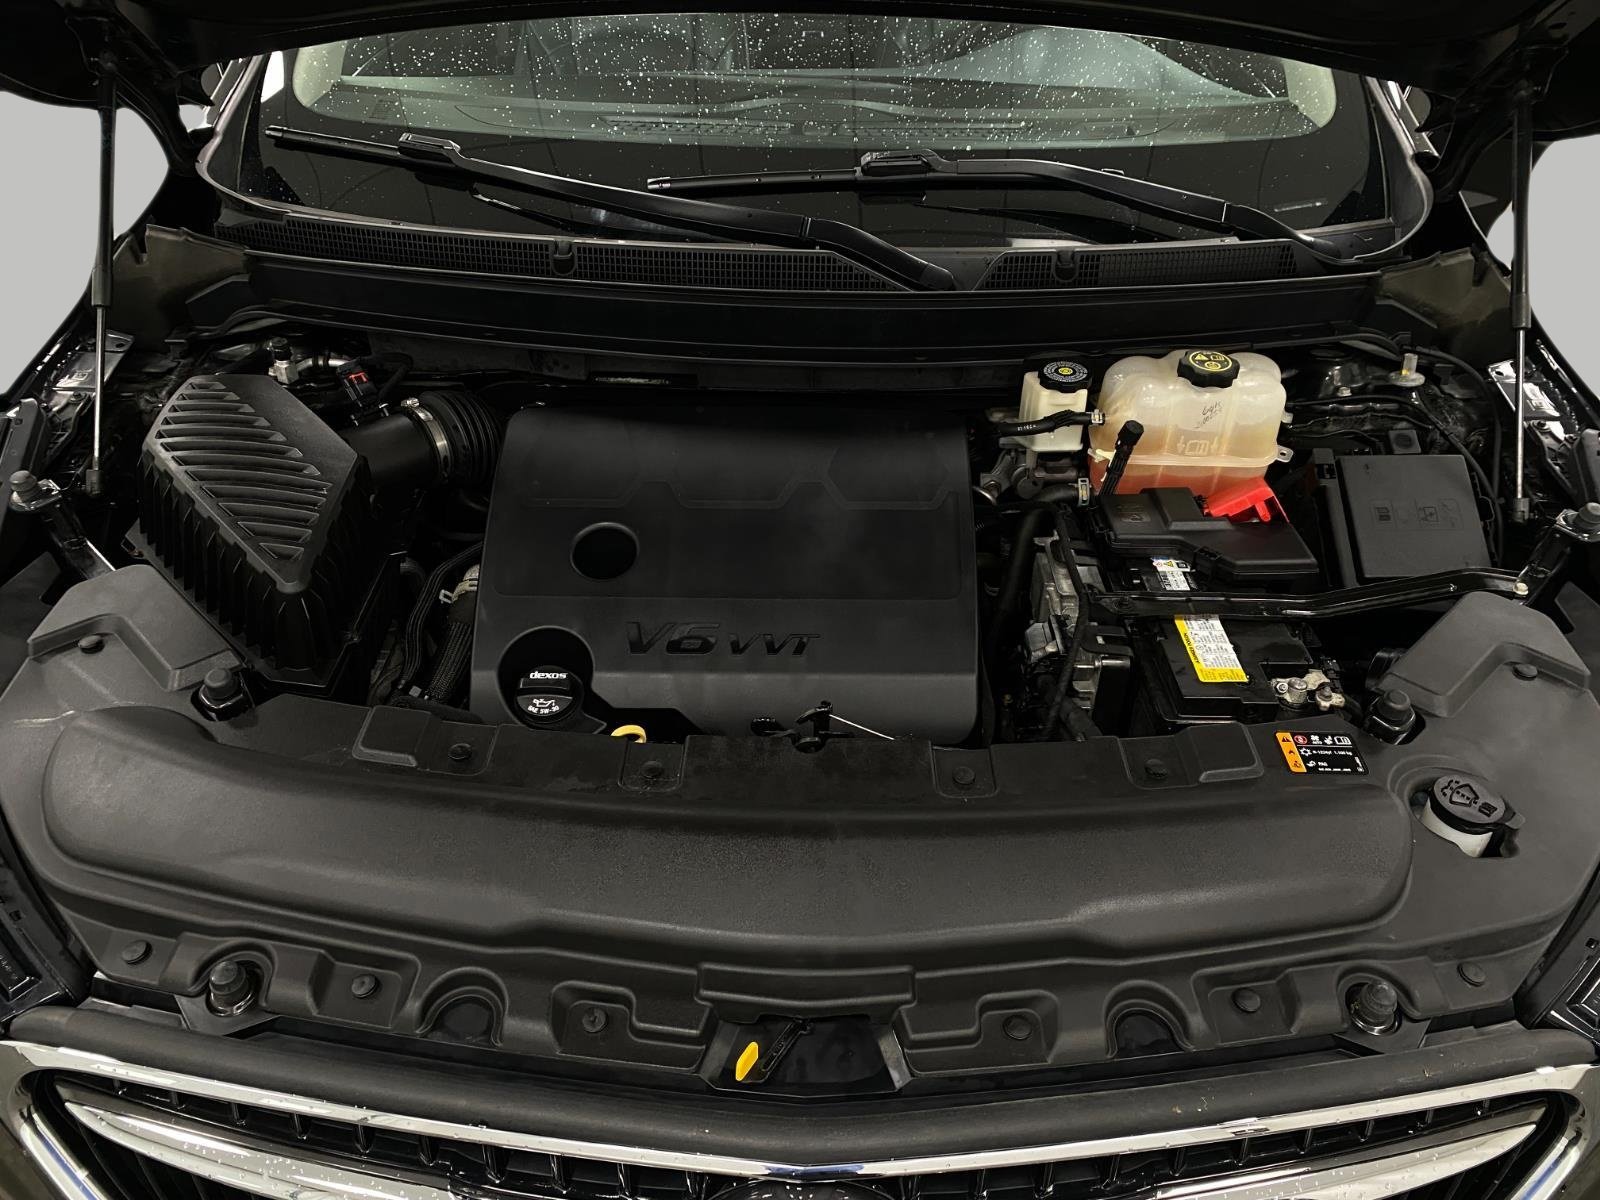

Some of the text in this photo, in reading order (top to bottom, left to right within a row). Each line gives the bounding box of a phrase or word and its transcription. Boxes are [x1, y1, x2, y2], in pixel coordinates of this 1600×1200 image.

[626, 621, 821, 655] V6 VVT
[529, 670, 569, 679] dexos
